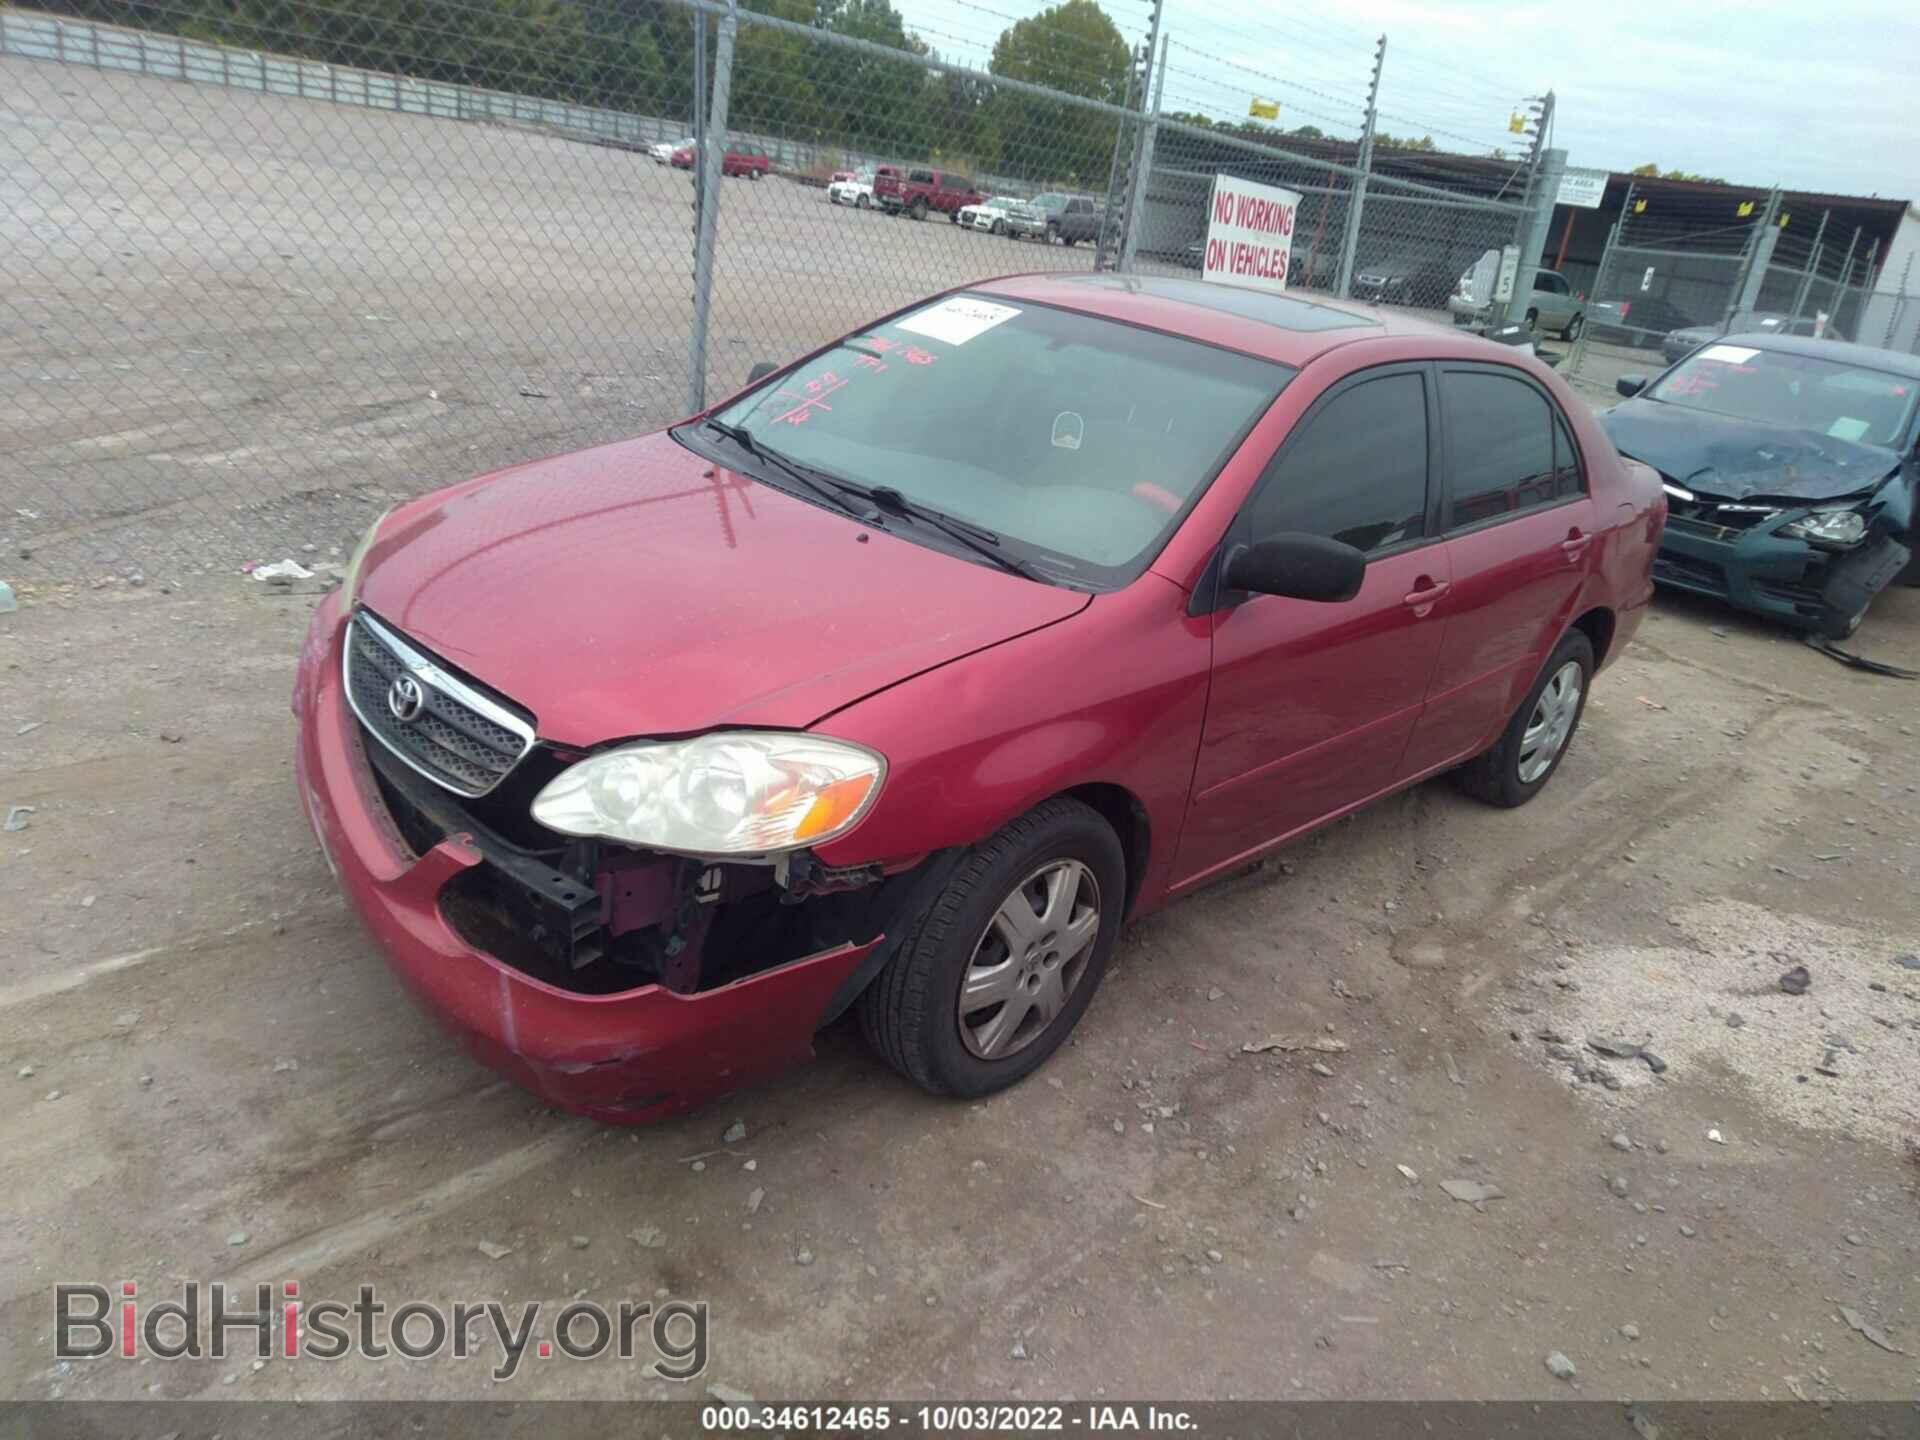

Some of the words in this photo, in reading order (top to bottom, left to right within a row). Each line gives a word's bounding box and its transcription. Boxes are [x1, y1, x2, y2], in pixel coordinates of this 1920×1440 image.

[1213, 190, 1234, 224] NO
[1235, 194, 1294, 236] WORKING
[1206, 238, 1228, 272] ON
[1229, 241, 1288, 281] VEHICLES
